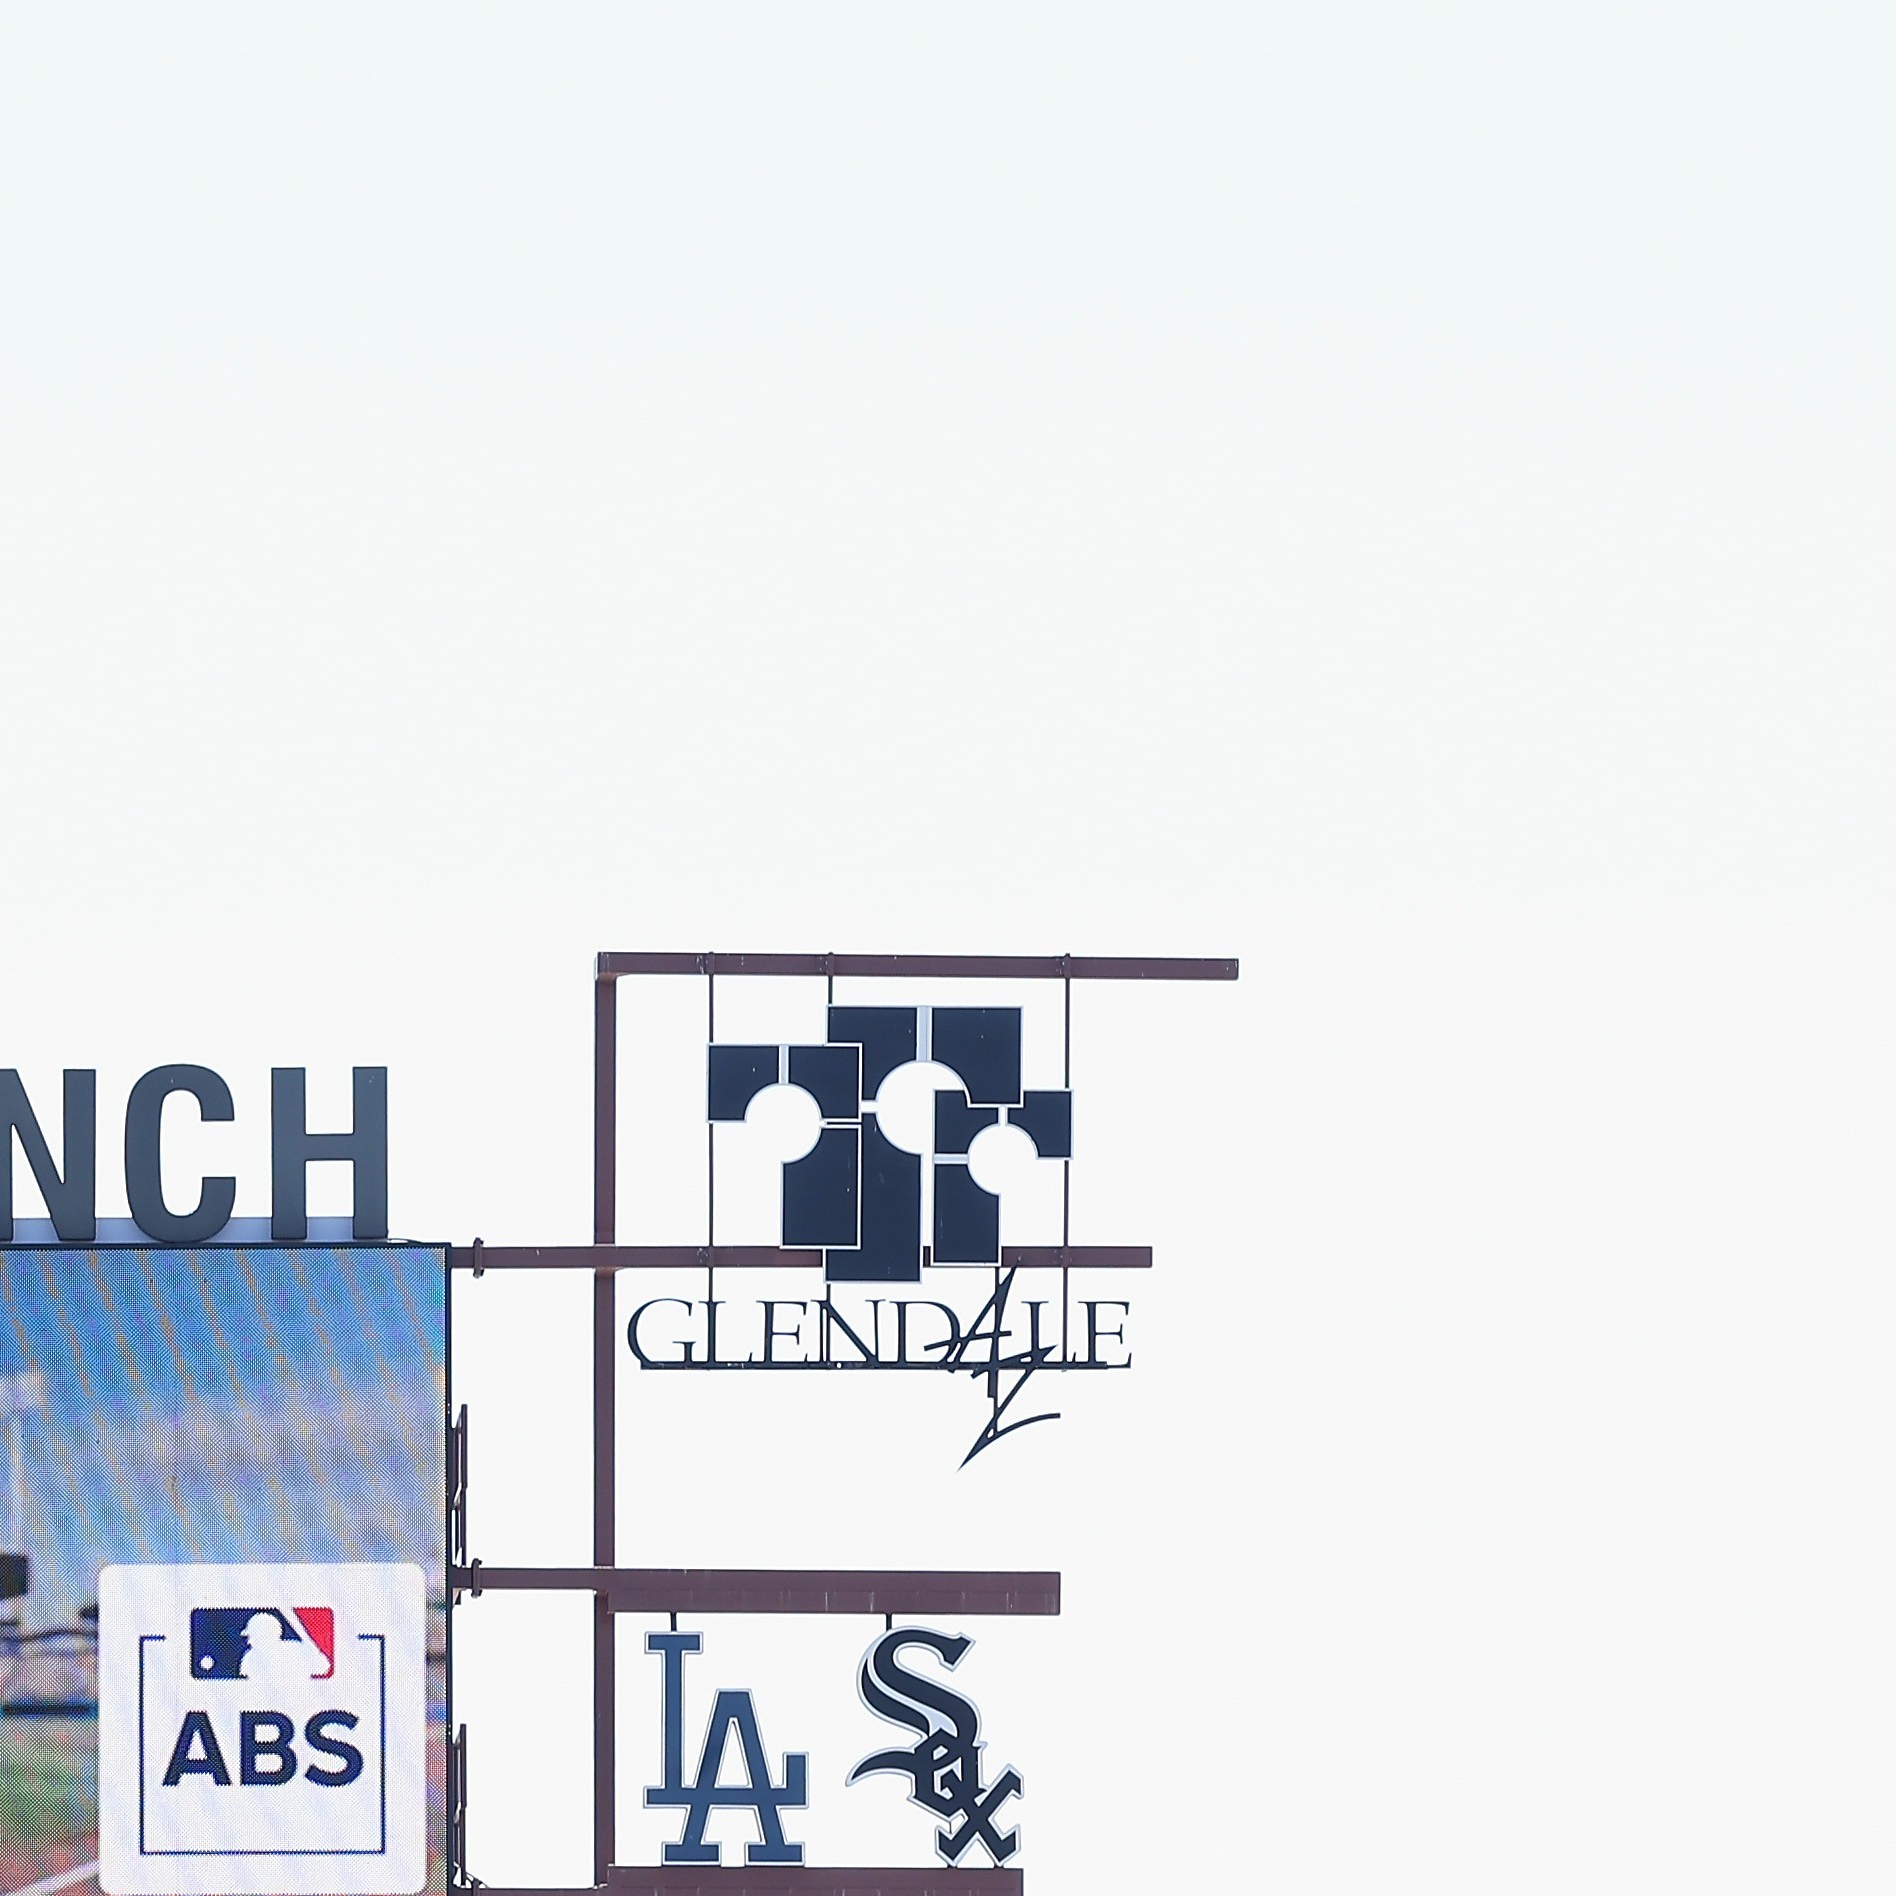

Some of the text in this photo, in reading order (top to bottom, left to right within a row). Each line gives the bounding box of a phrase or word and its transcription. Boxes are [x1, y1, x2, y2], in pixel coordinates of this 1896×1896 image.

[626, 1266, 1133, 1372] GLENDALE
[162, 1709, 365, 1787] ABS
[644, 1632, 809, 1866] LA
